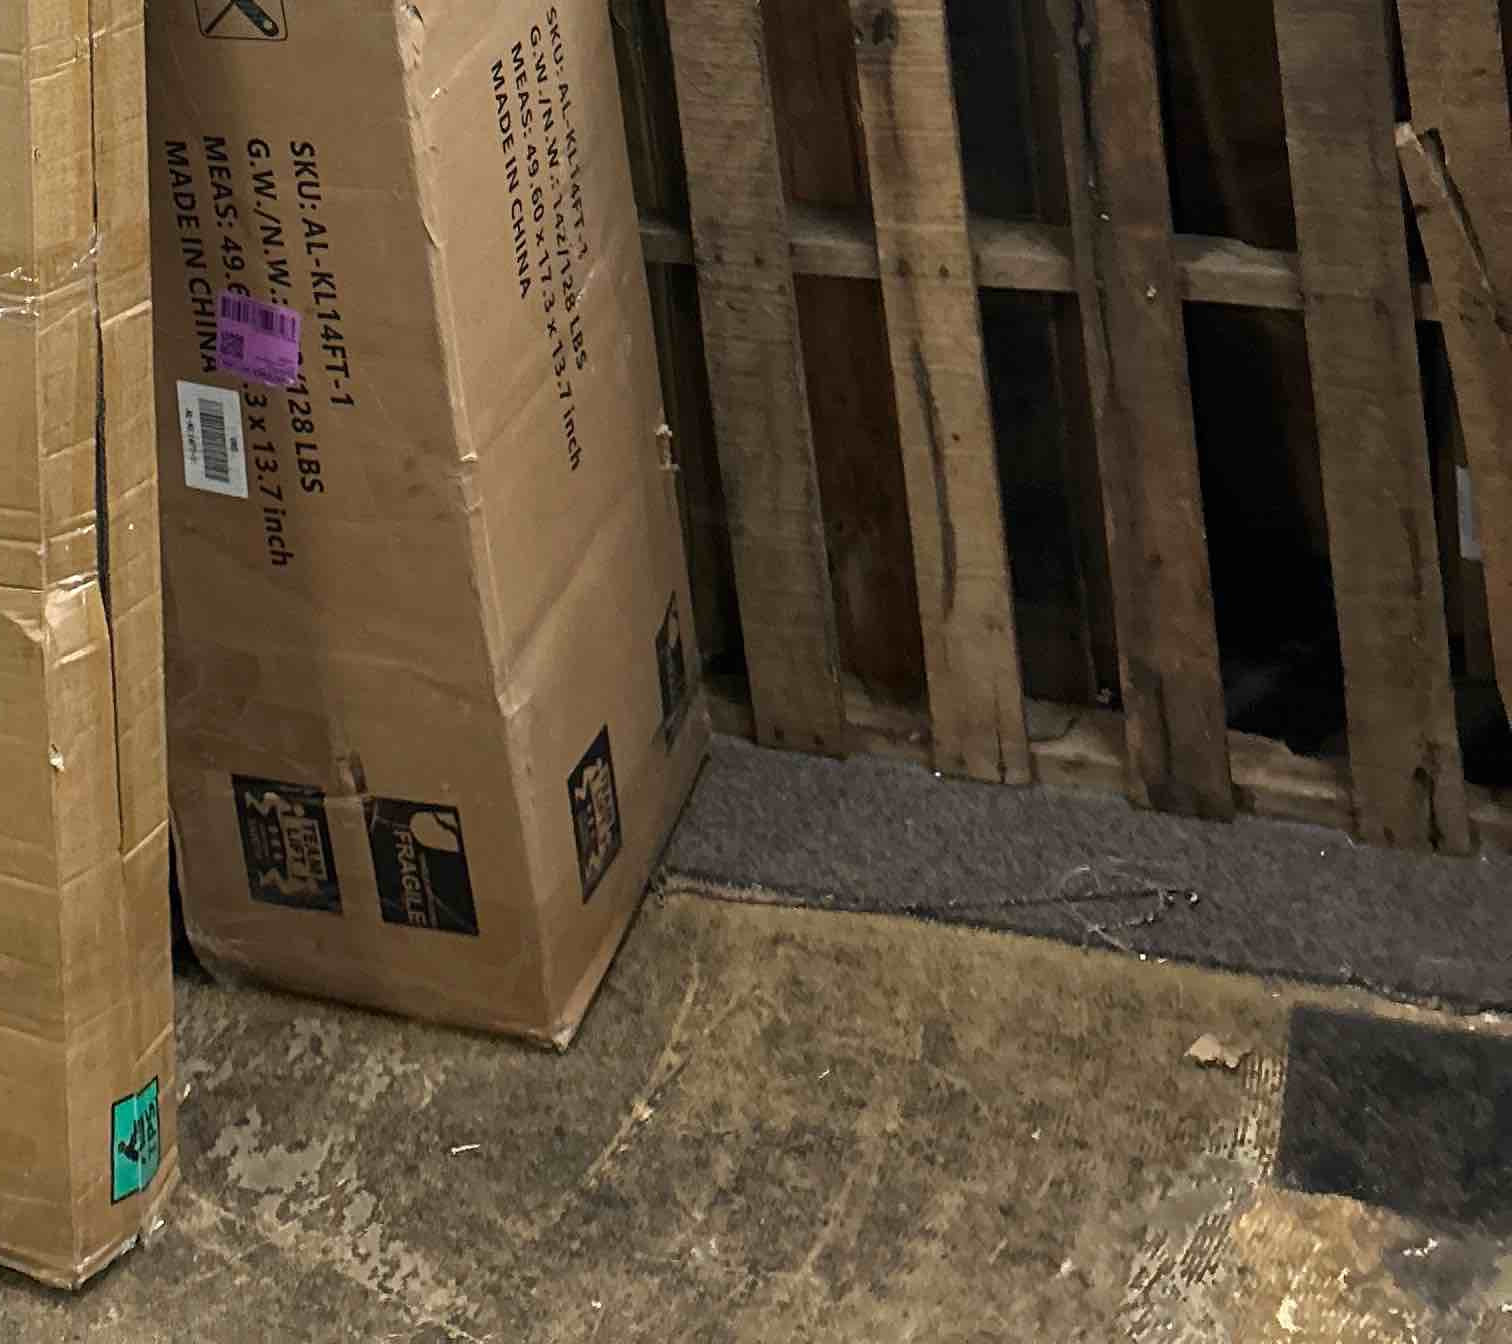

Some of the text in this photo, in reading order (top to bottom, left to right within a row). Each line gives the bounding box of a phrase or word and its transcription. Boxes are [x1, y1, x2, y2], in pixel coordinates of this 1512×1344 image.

[545, 6, 566, 76] SKU:
[202, 135, 238, 228] MEAS:
[490, 58, 533, 300] MADE IN CHINA
[164, 140, 217, 375] MADE IN CHINA
[289, 140, 355, 408] SKU: AL-KL14FT-1
[510, 41, 534, 139] MEAS:
[525, 143, 546, 229] 49.60
[537, 252, 557, 315] 17.3
[548, 341, 574, 402] 13.7
[561, 406, 582, 472] inch
[567, 315, 588, 372] LBS
[252, 441, 284, 503] 13.7
[295, 440, 325, 495] LBS
[263, 509, 295, 569] inch
[303, 818, 327, 880] TEAM
[395, 830, 427, 928] FRAGILE
